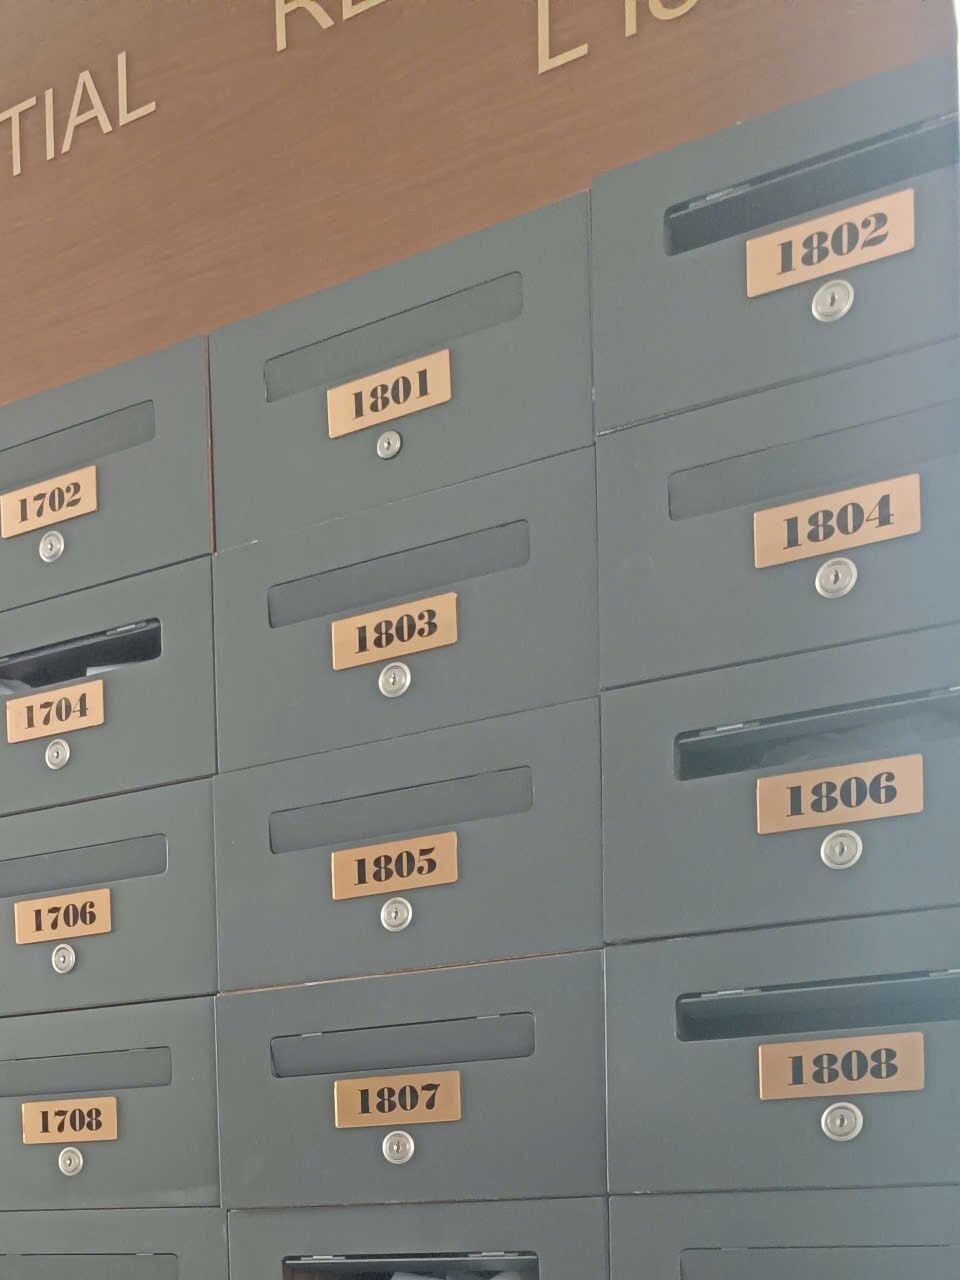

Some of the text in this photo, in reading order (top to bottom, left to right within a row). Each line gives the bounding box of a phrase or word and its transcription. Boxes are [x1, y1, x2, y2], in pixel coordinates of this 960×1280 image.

[777, 212, 889, 276] 1802
[353, 368, 429, 419] 1801
[19, 482, 81, 523] 1702
[782, 494, 895, 551] 1804
[355, 609, 438, 654] 1803
[26, 692, 89, 729] 1704
[785, 771, 898, 818] 1806
[354, 850, 437, 886] 1805
[34, 901, 97, 932] 1706
[787, 1048, 898, 1087] 1808
[358, 1083, 441, 1115] 1807
[40, 1108, 103, 1134] 1708
